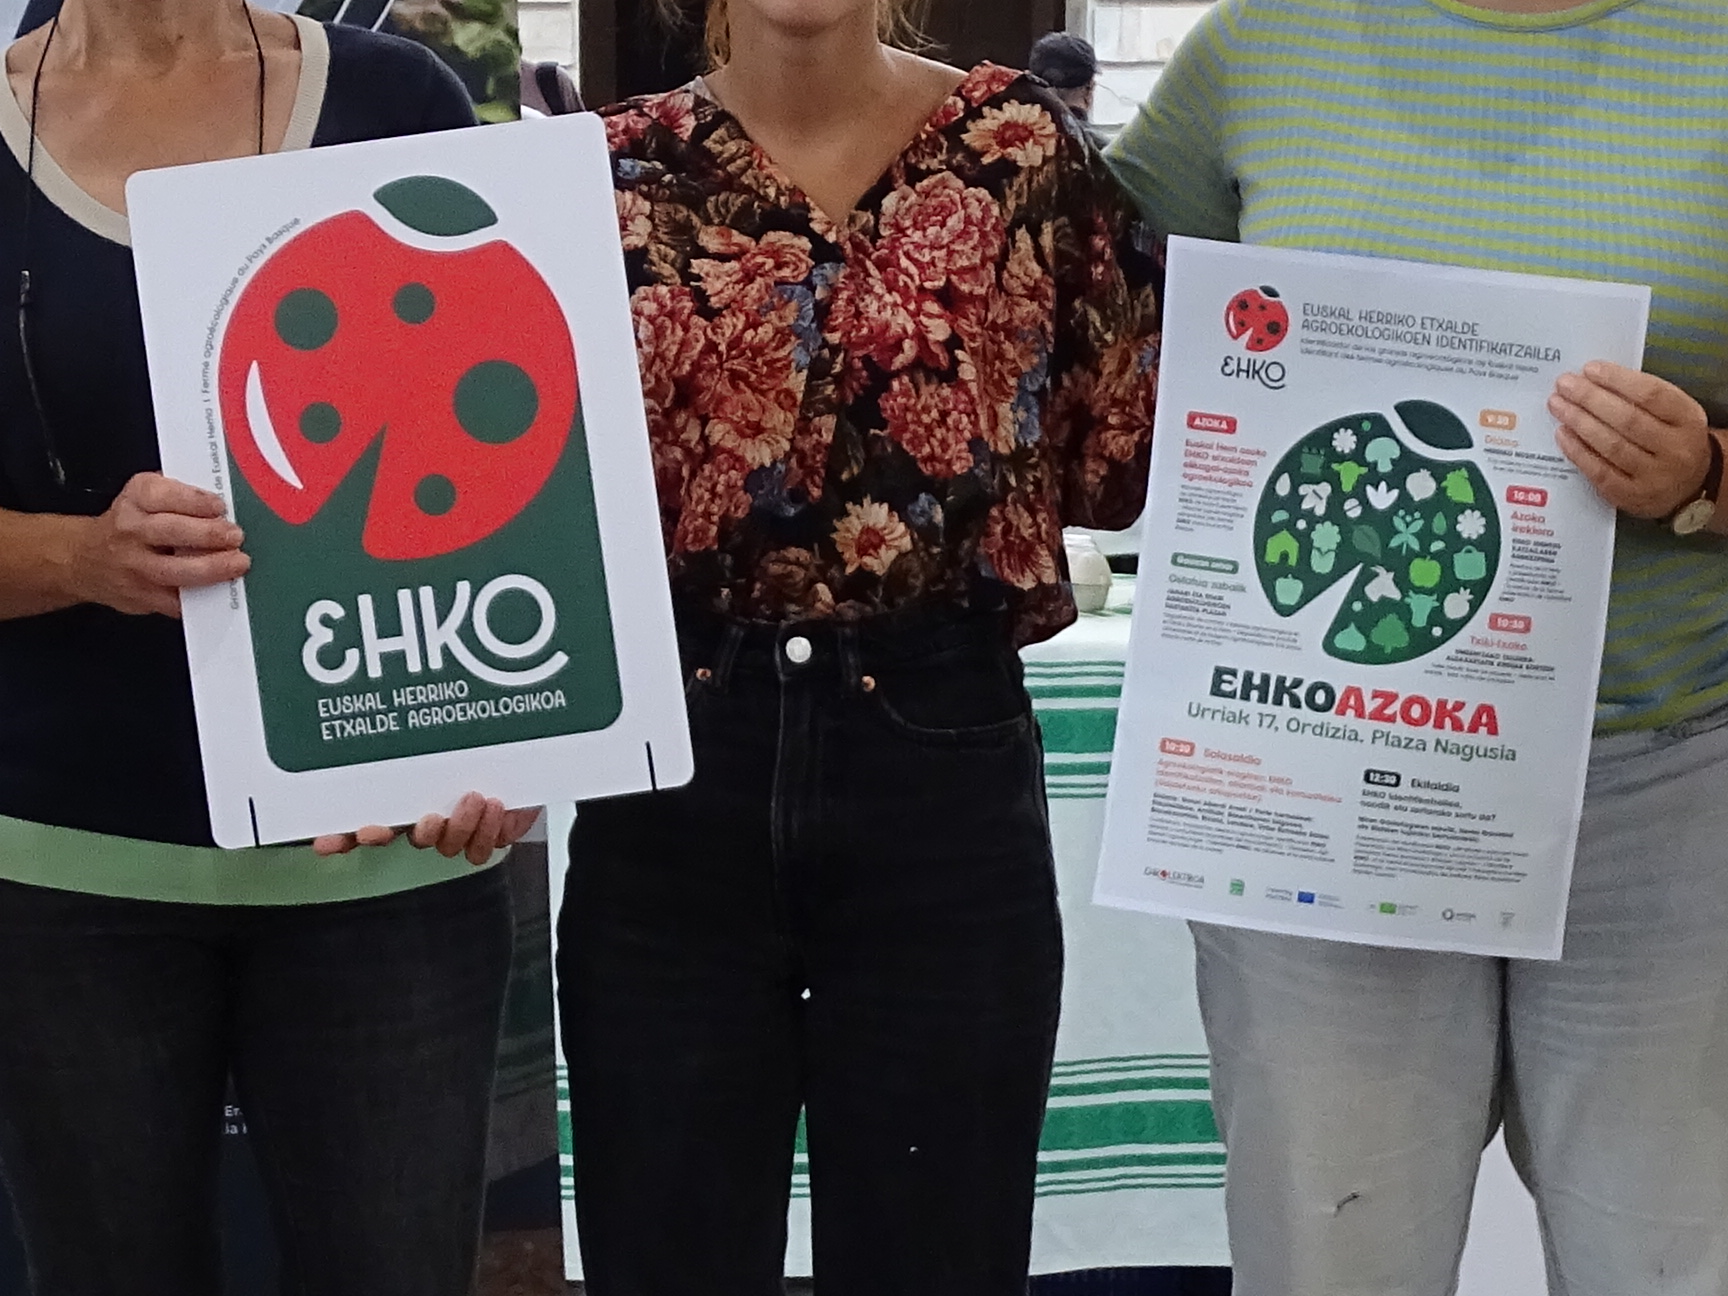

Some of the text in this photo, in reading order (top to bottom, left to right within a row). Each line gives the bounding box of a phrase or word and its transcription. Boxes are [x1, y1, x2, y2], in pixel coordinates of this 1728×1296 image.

[237, 263, 249, 277] du
[1302, 303, 1480, 336] EUSKAL HERRIKO ETXALDE
[1301, 318, 1561, 362] AGROEKOLOGIKOEN IDENTIFIKATZAILEA
[1220, 355, 1286, 390] EHKO
[1193, 417, 1228, 430] AZOKA
[302, 573, 570, 686] EHKO
[318, 679, 470, 718] EUSKAL HERRIKO
[321, 689, 567, 741] ETXALDE AGROEKOLOGIKOA
[1209, 665, 1500, 736] EHKOAZOKA
[1187, 701, 1250, 727] Urriak
[1371, 729, 1427, 753] Plaza
[1433, 738, 1517, 763] Nagusia
[1410, 778, 1460, 793] Ekitaldia
